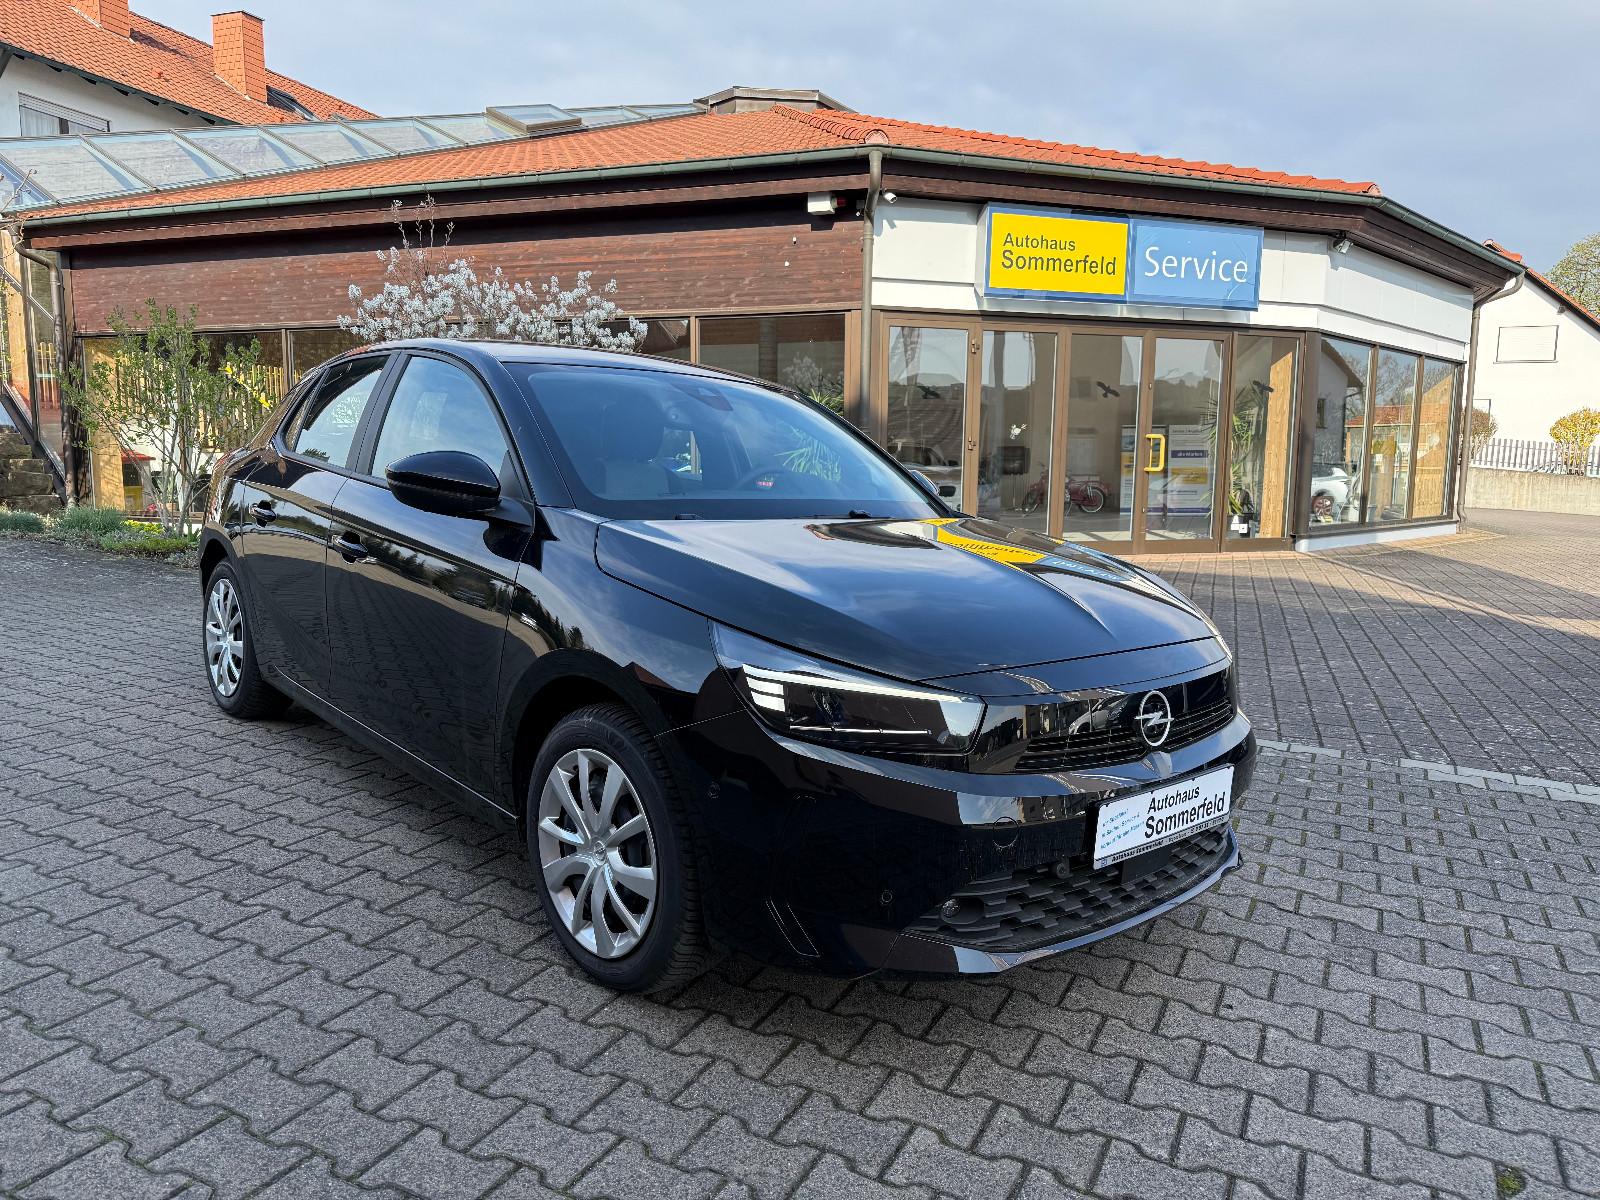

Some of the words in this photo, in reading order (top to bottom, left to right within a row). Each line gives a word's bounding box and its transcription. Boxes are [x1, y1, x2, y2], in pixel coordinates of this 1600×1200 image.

[1003, 232, 1076, 252] Autohaus
[1001, 249, 1117, 276] Sommerfeld
[1144, 246, 1249, 283] Service
[1147, 786, 1200, 814] Autohaus
[1144, 792, 1226, 839] Sommerfeld
